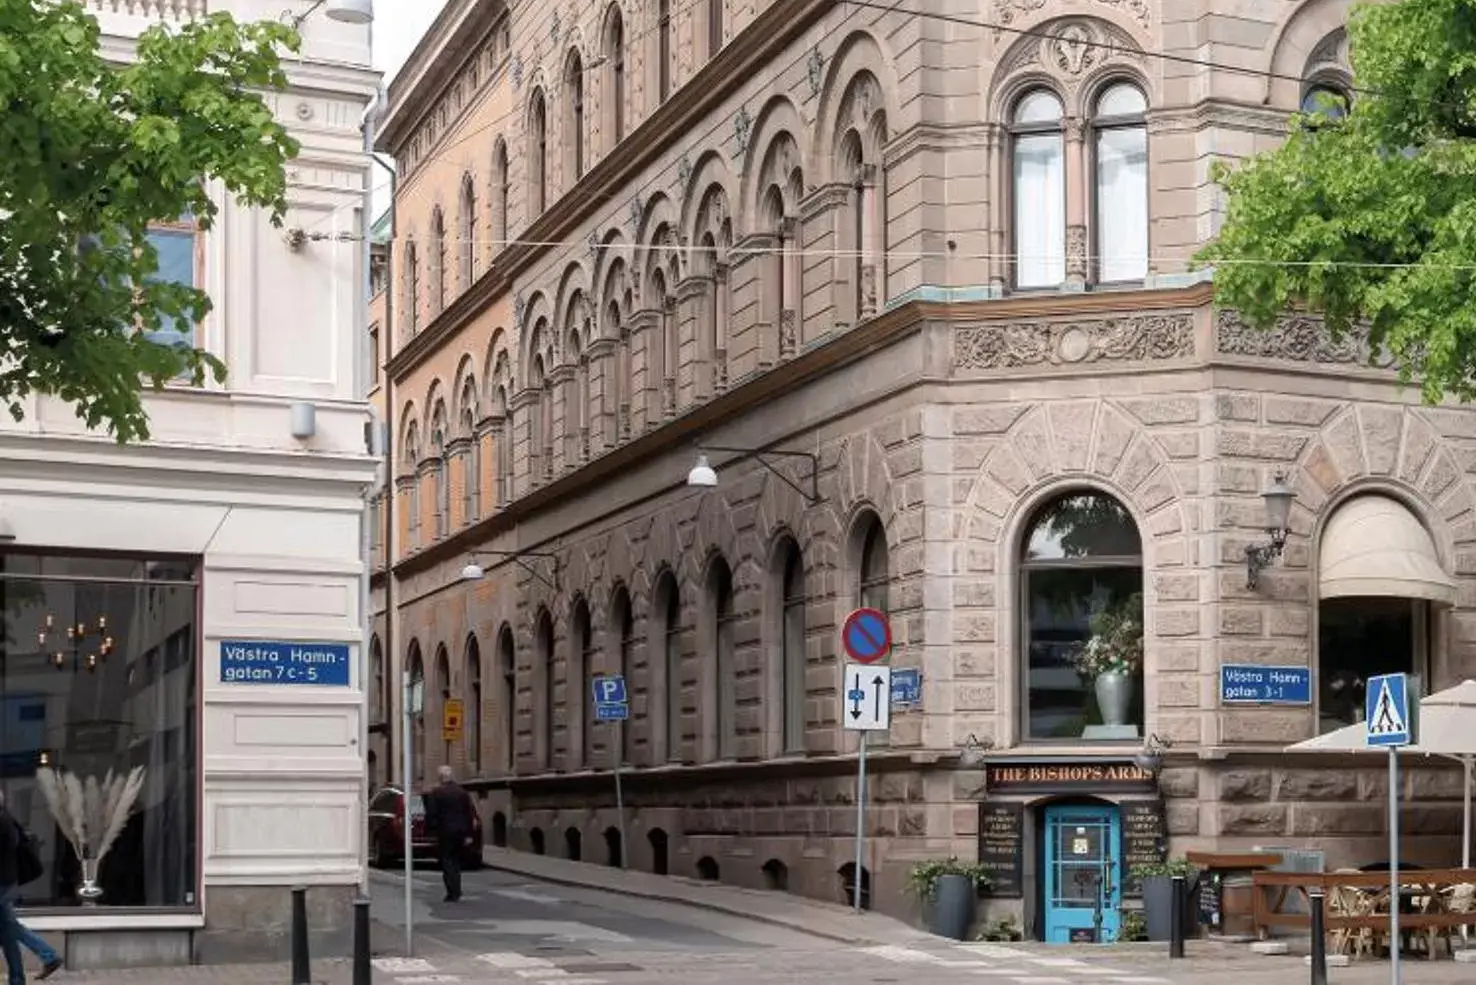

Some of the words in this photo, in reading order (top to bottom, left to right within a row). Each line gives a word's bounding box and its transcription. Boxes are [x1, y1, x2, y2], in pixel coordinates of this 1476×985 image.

[225, 646, 279, 662] Västra
[225, 666, 272, 681] gatan
[1226, 668, 1263, 683] Västra
[602, 681, 617, 700] P
[1226, 685, 1258, 699] gatan
[992, 767, 1025, 782] THE
[1028, 766, 1103, 781] BISHOPS
[1105, 765, 1154, 781] ARMS
